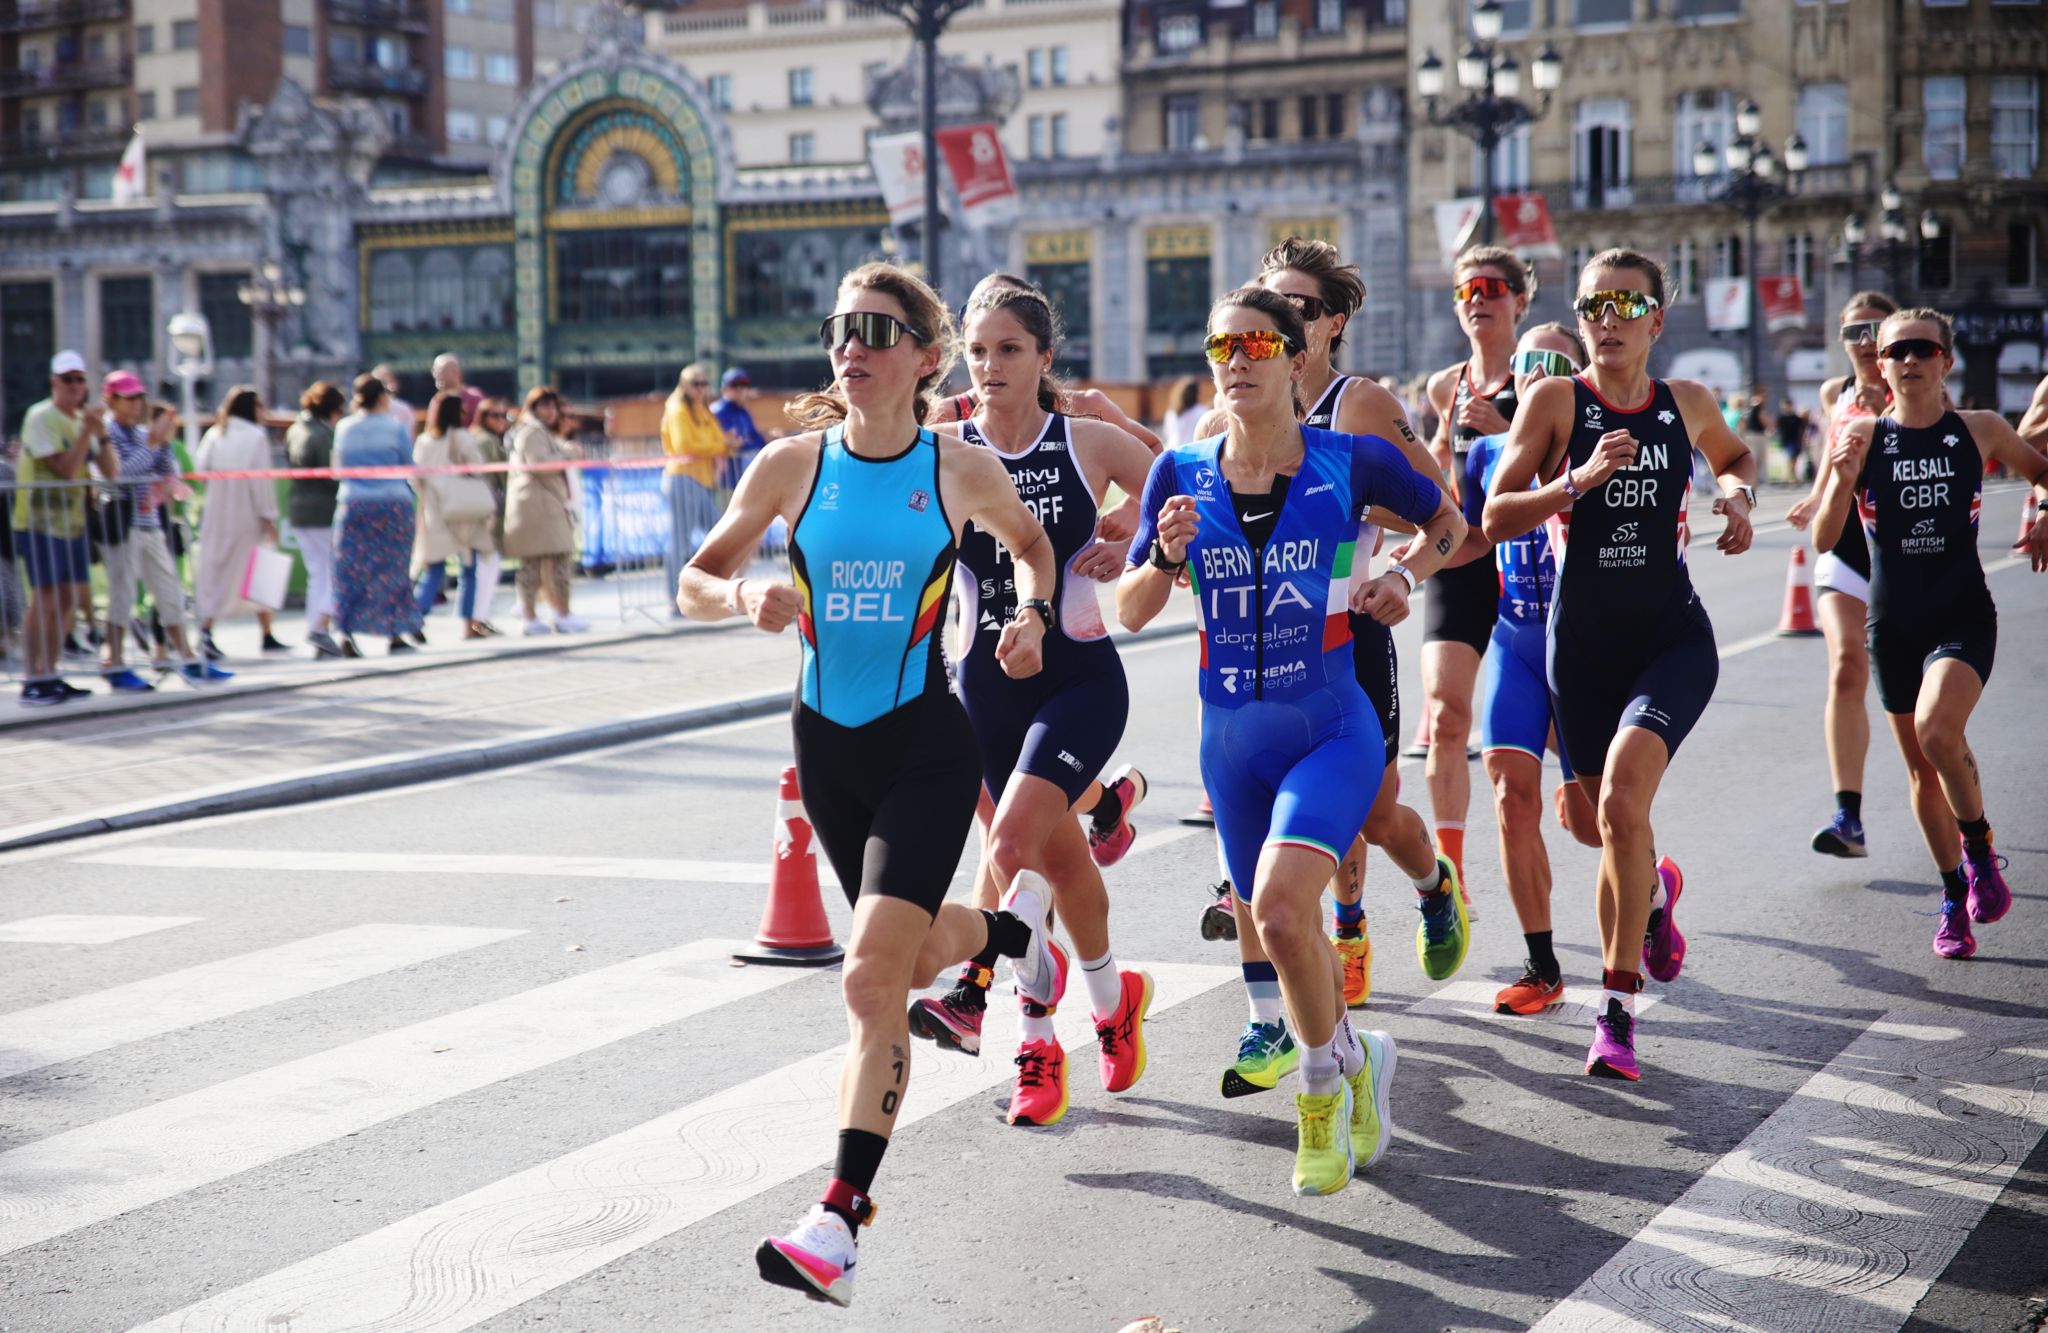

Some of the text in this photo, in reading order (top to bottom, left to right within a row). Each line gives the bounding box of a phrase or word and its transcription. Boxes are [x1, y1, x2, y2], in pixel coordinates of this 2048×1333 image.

[1893, 457, 1955, 482] KELSALL
[1196, 489, 1213, 497] World
[1304, 482, 1335, 496] Santini
[1605, 479, 1658, 507] GBR
[1900, 483, 1950, 509] GBR
[1599, 545, 1647, 559] BRITISH
[1901, 537, 1945, 548] BRITISH
[1902, 546, 1945, 555] TRIATHLON
[1201, 538, 1319, 579] BERNARDI
[1599, 558, 1646, 568] TRIATHLON
[831, 560, 905, 589] RICOUR
[825, 593, 904, 622] BEL
[1211, 581, 1313, 619] ITA
[1242, 670, 1307, 692] energia
[1243, 660, 1307, 680] THEMA
[1389, 687, 1397, 720] Paris
